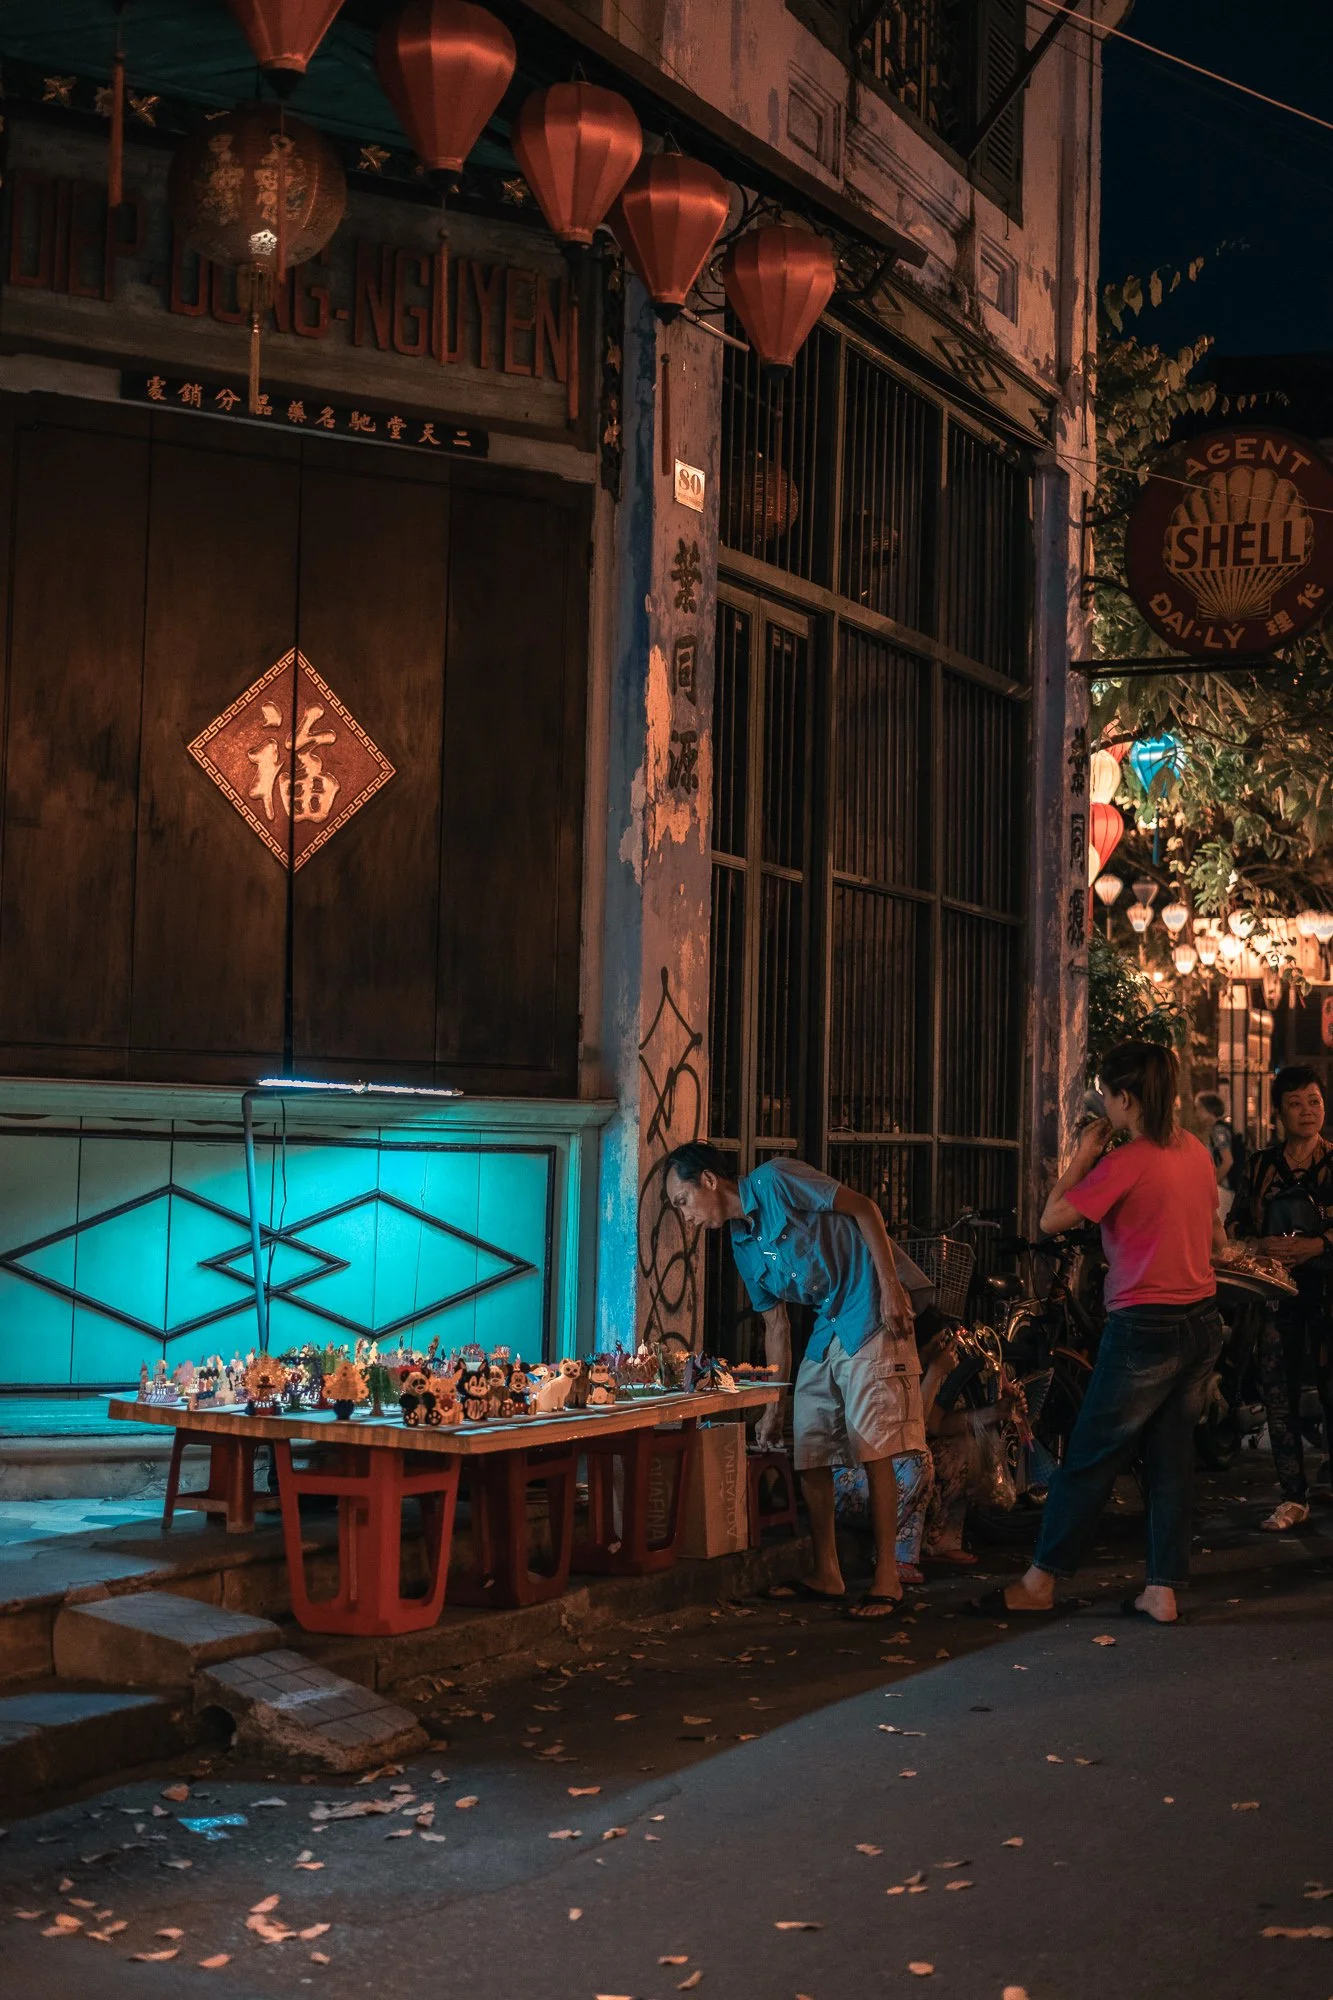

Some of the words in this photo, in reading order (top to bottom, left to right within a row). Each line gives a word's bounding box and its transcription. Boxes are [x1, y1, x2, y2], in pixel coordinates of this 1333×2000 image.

[679, 468, 702, 495] 80
[1185, 438, 1312, 479] AGENT
[1174, 520, 1302, 570] SHELL
[248, 701, 340, 823] 福
[647, 1457, 667, 1539] QUAFINA
[725, 1440, 737, 1537] AQUAFINA
